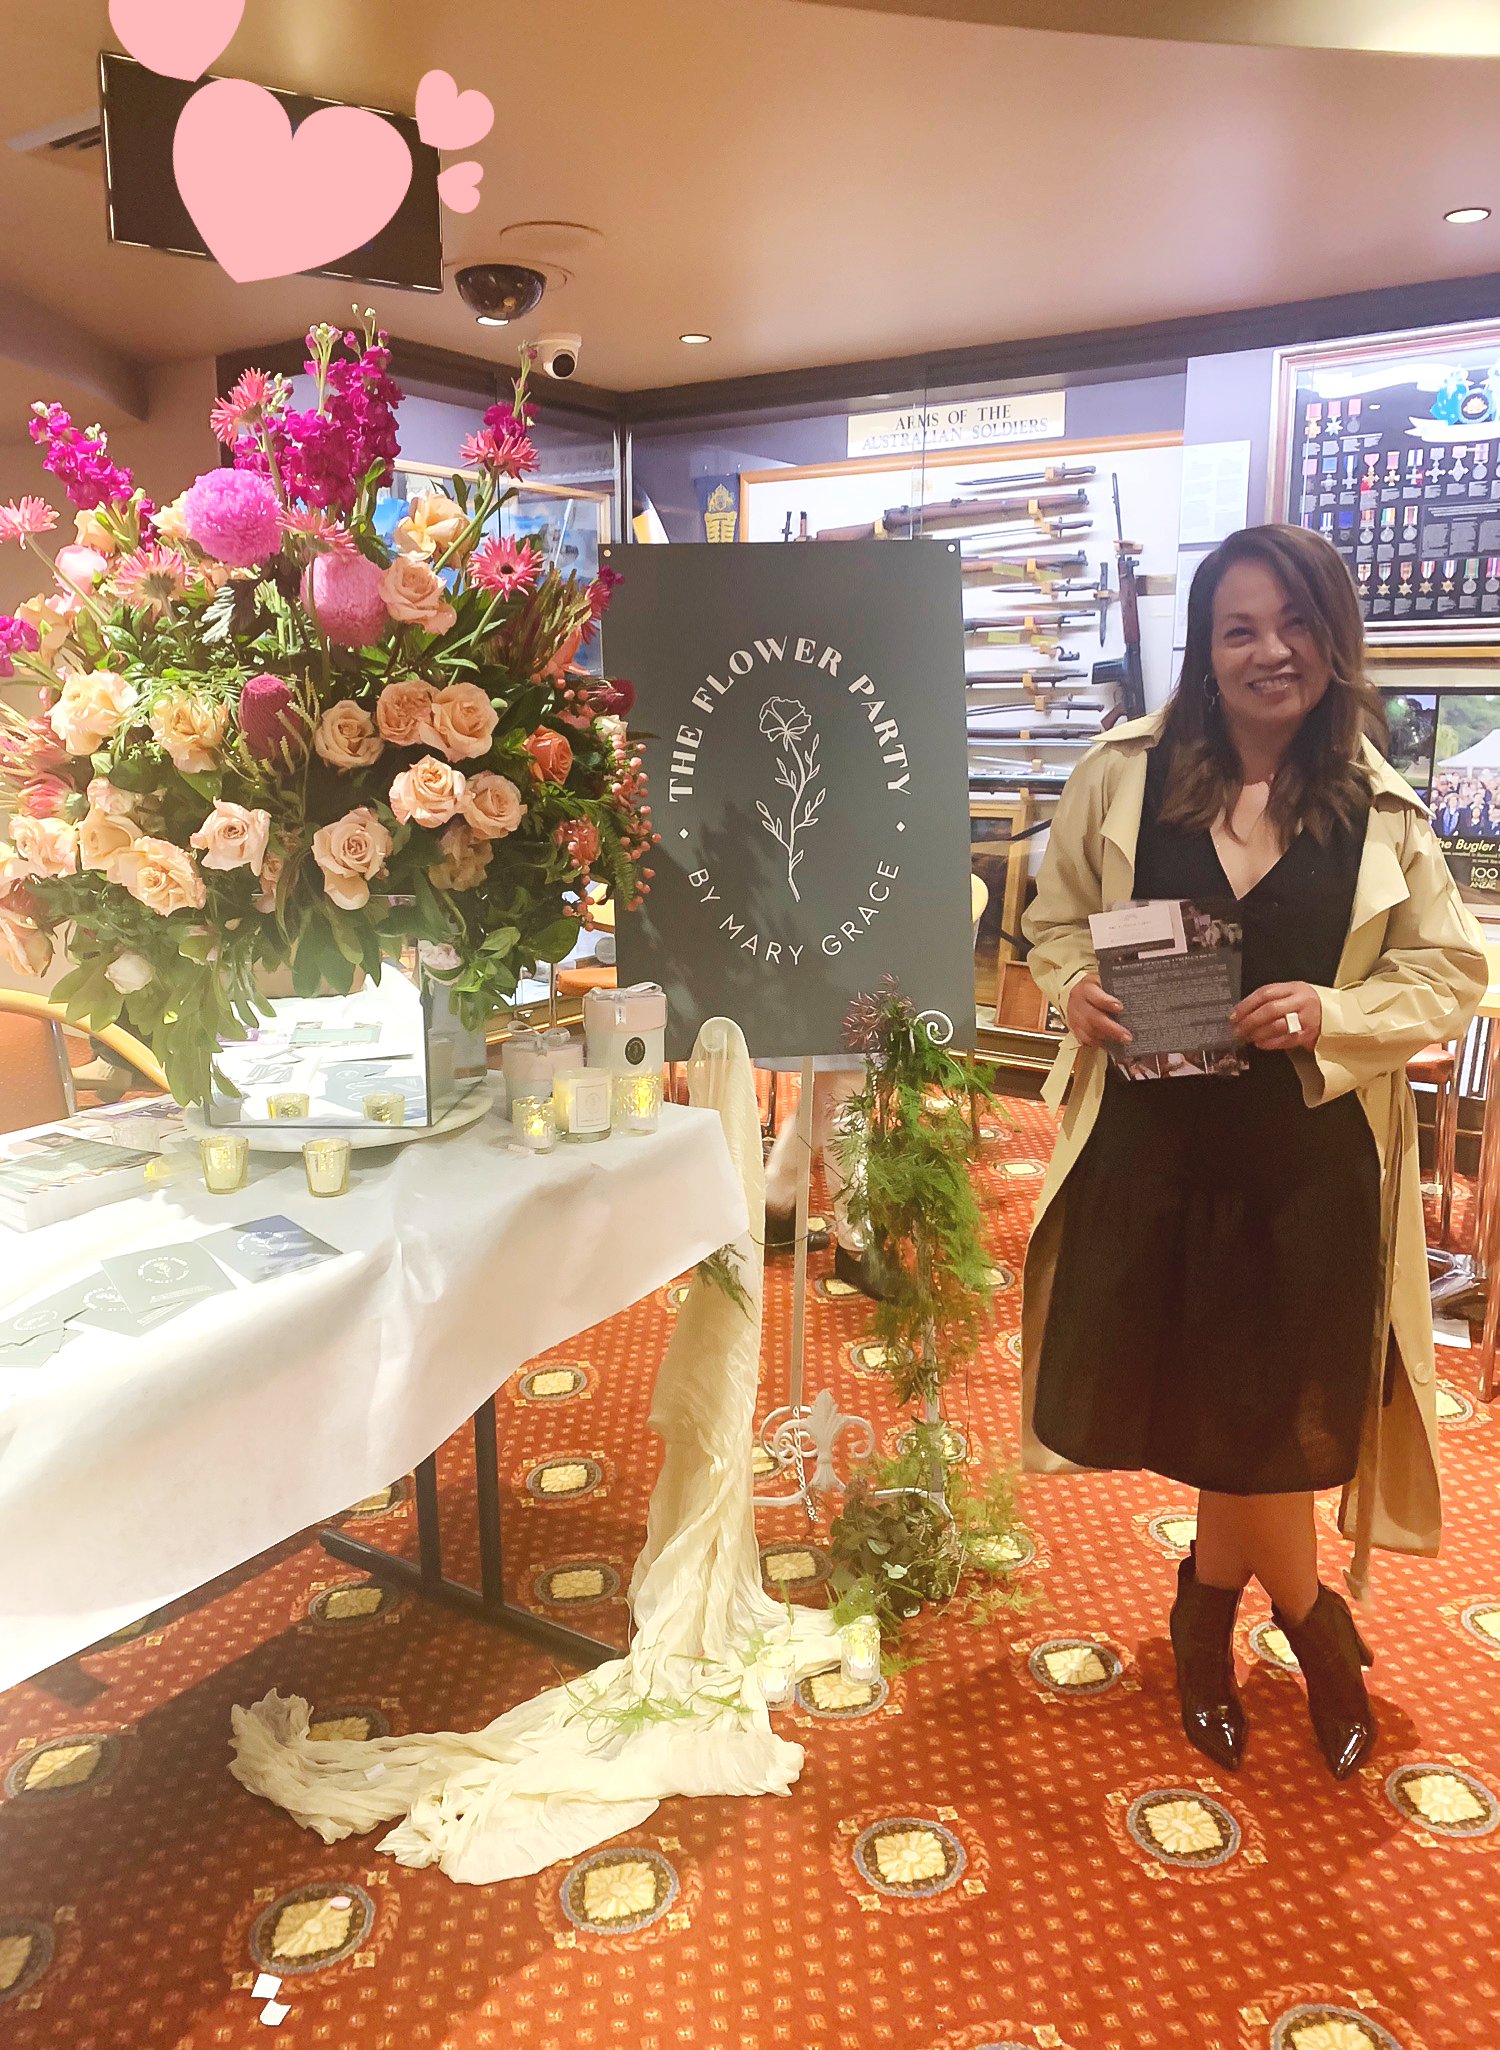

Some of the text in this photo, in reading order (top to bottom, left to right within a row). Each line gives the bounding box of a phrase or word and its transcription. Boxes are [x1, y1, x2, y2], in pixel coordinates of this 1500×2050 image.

[895, 405, 1012, 431] ARMS OF THE
[863, 418, 1048, 450] AUSTRALIAN SOLDIERS
[669, 636, 911, 803] THE FLOWER PARTY
[1438, 838, 1452, 849] he
[1456, 839, 1495, 852] Bugler
[1471, 867, 1498, 879] 100
[688, 860, 899, 965] BY MARY GRACE
